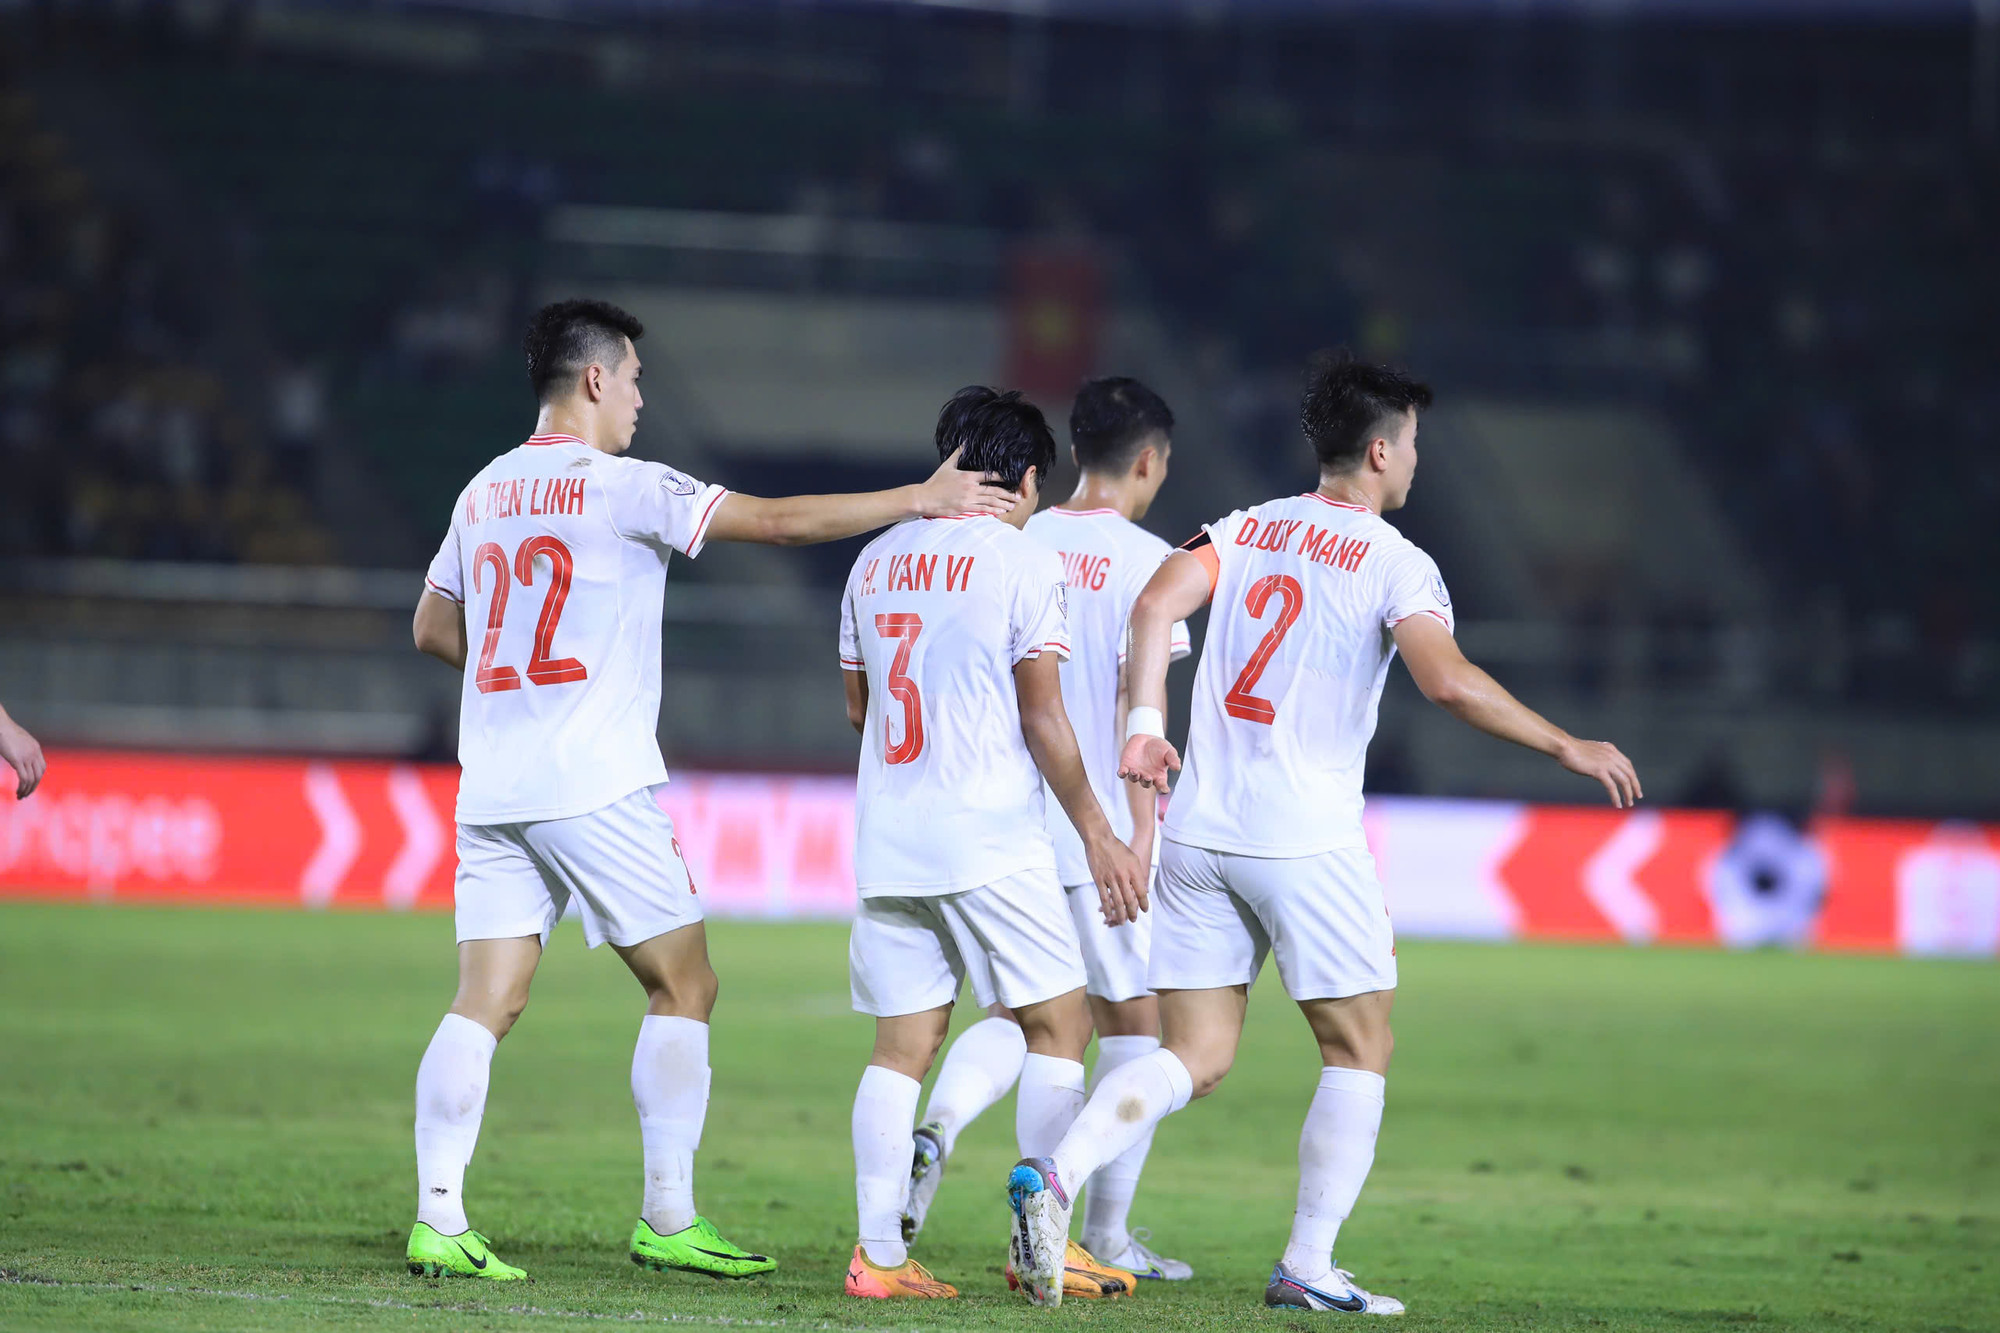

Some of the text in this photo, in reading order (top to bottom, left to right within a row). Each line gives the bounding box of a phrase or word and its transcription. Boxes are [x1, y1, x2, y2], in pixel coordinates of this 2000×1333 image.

[486, 478, 526, 520] TIEN
[530, 478, 586, 515] LINH
[1297, 524, 1370, 573] MANH
[473, 535, 588, 694] 22
[888, 553, 938, 592] VAN
[946, 554, 975, 592] VI
[875, 613, 923, 765] 3
[1225, 574, 1303, 725] 2
